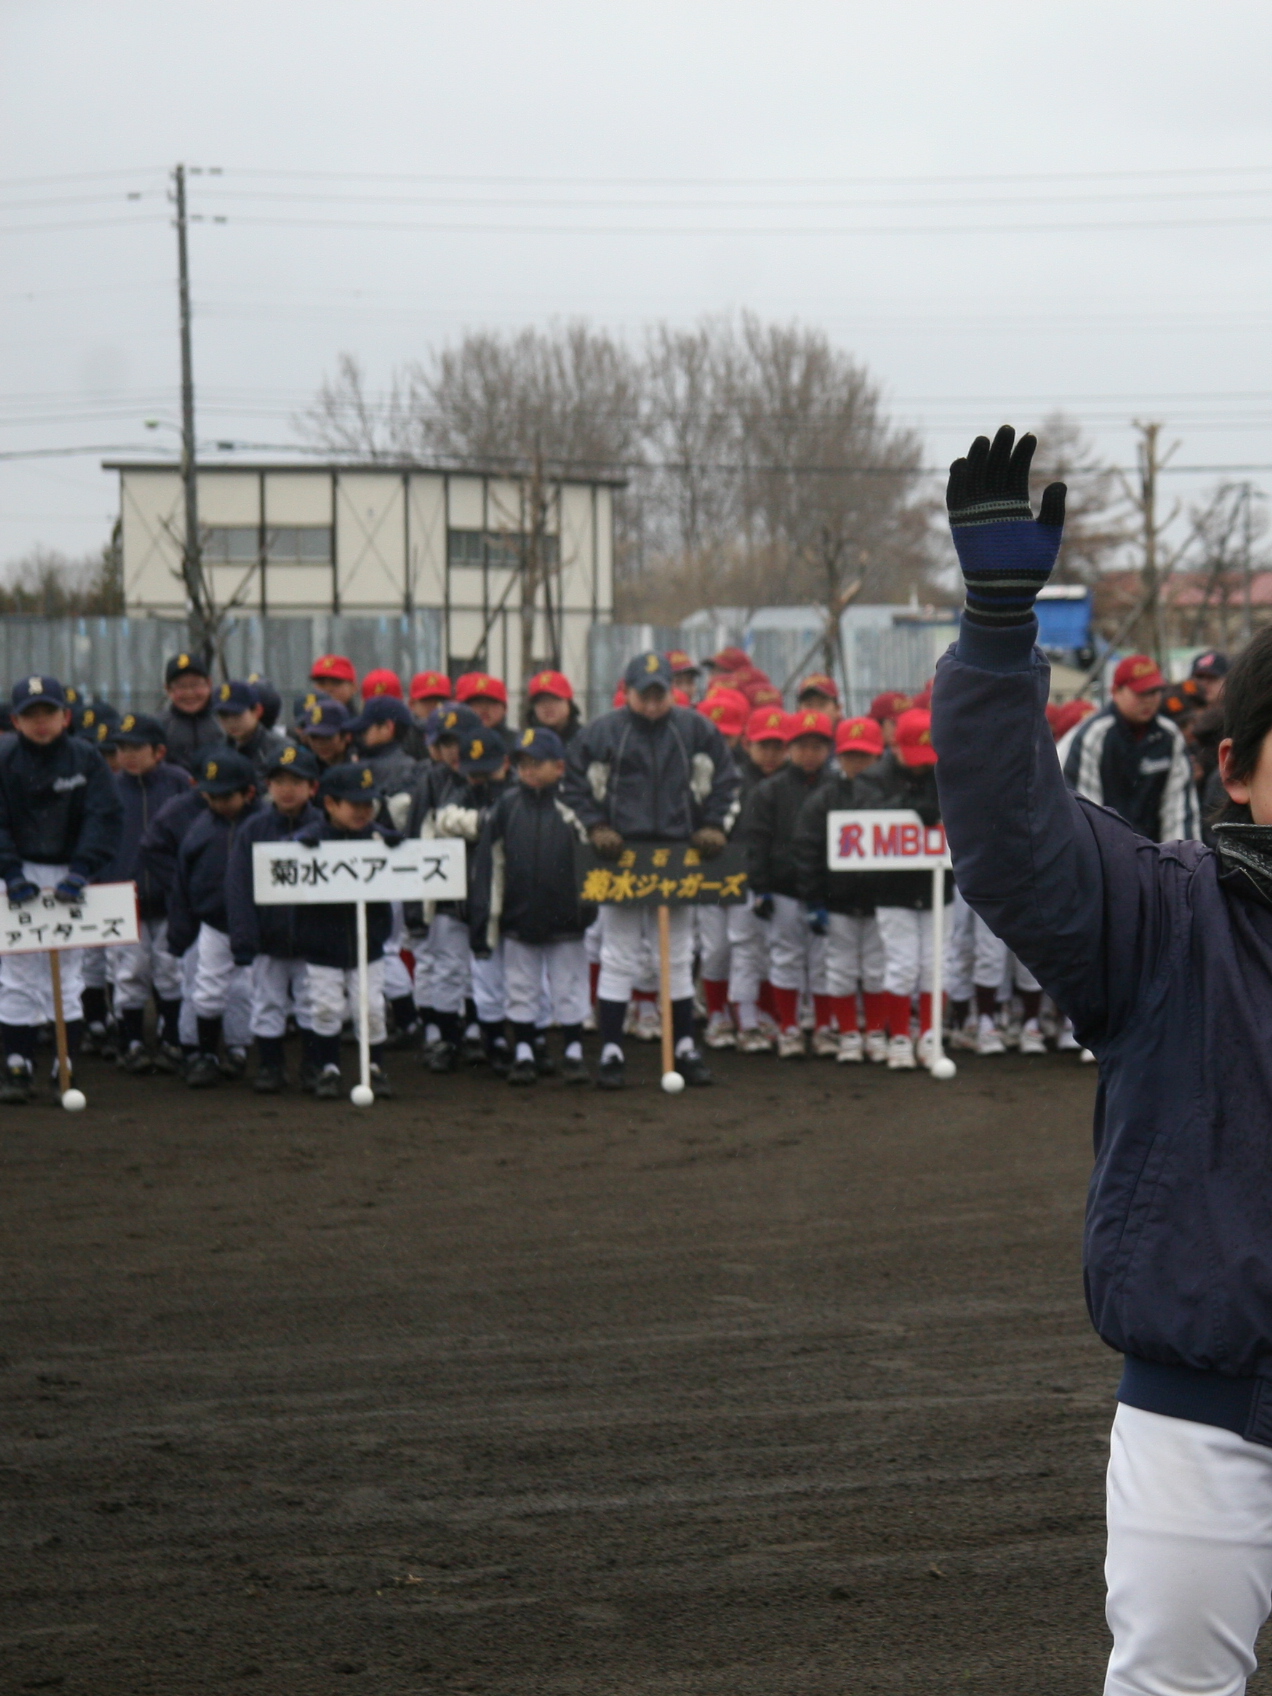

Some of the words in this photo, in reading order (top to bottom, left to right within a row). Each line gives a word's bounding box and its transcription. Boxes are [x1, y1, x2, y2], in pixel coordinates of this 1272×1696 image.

[270, 854, 449, 887] 菊水ベアーズ
[581, 867, 748, 902] 菊水ジャガーズ
